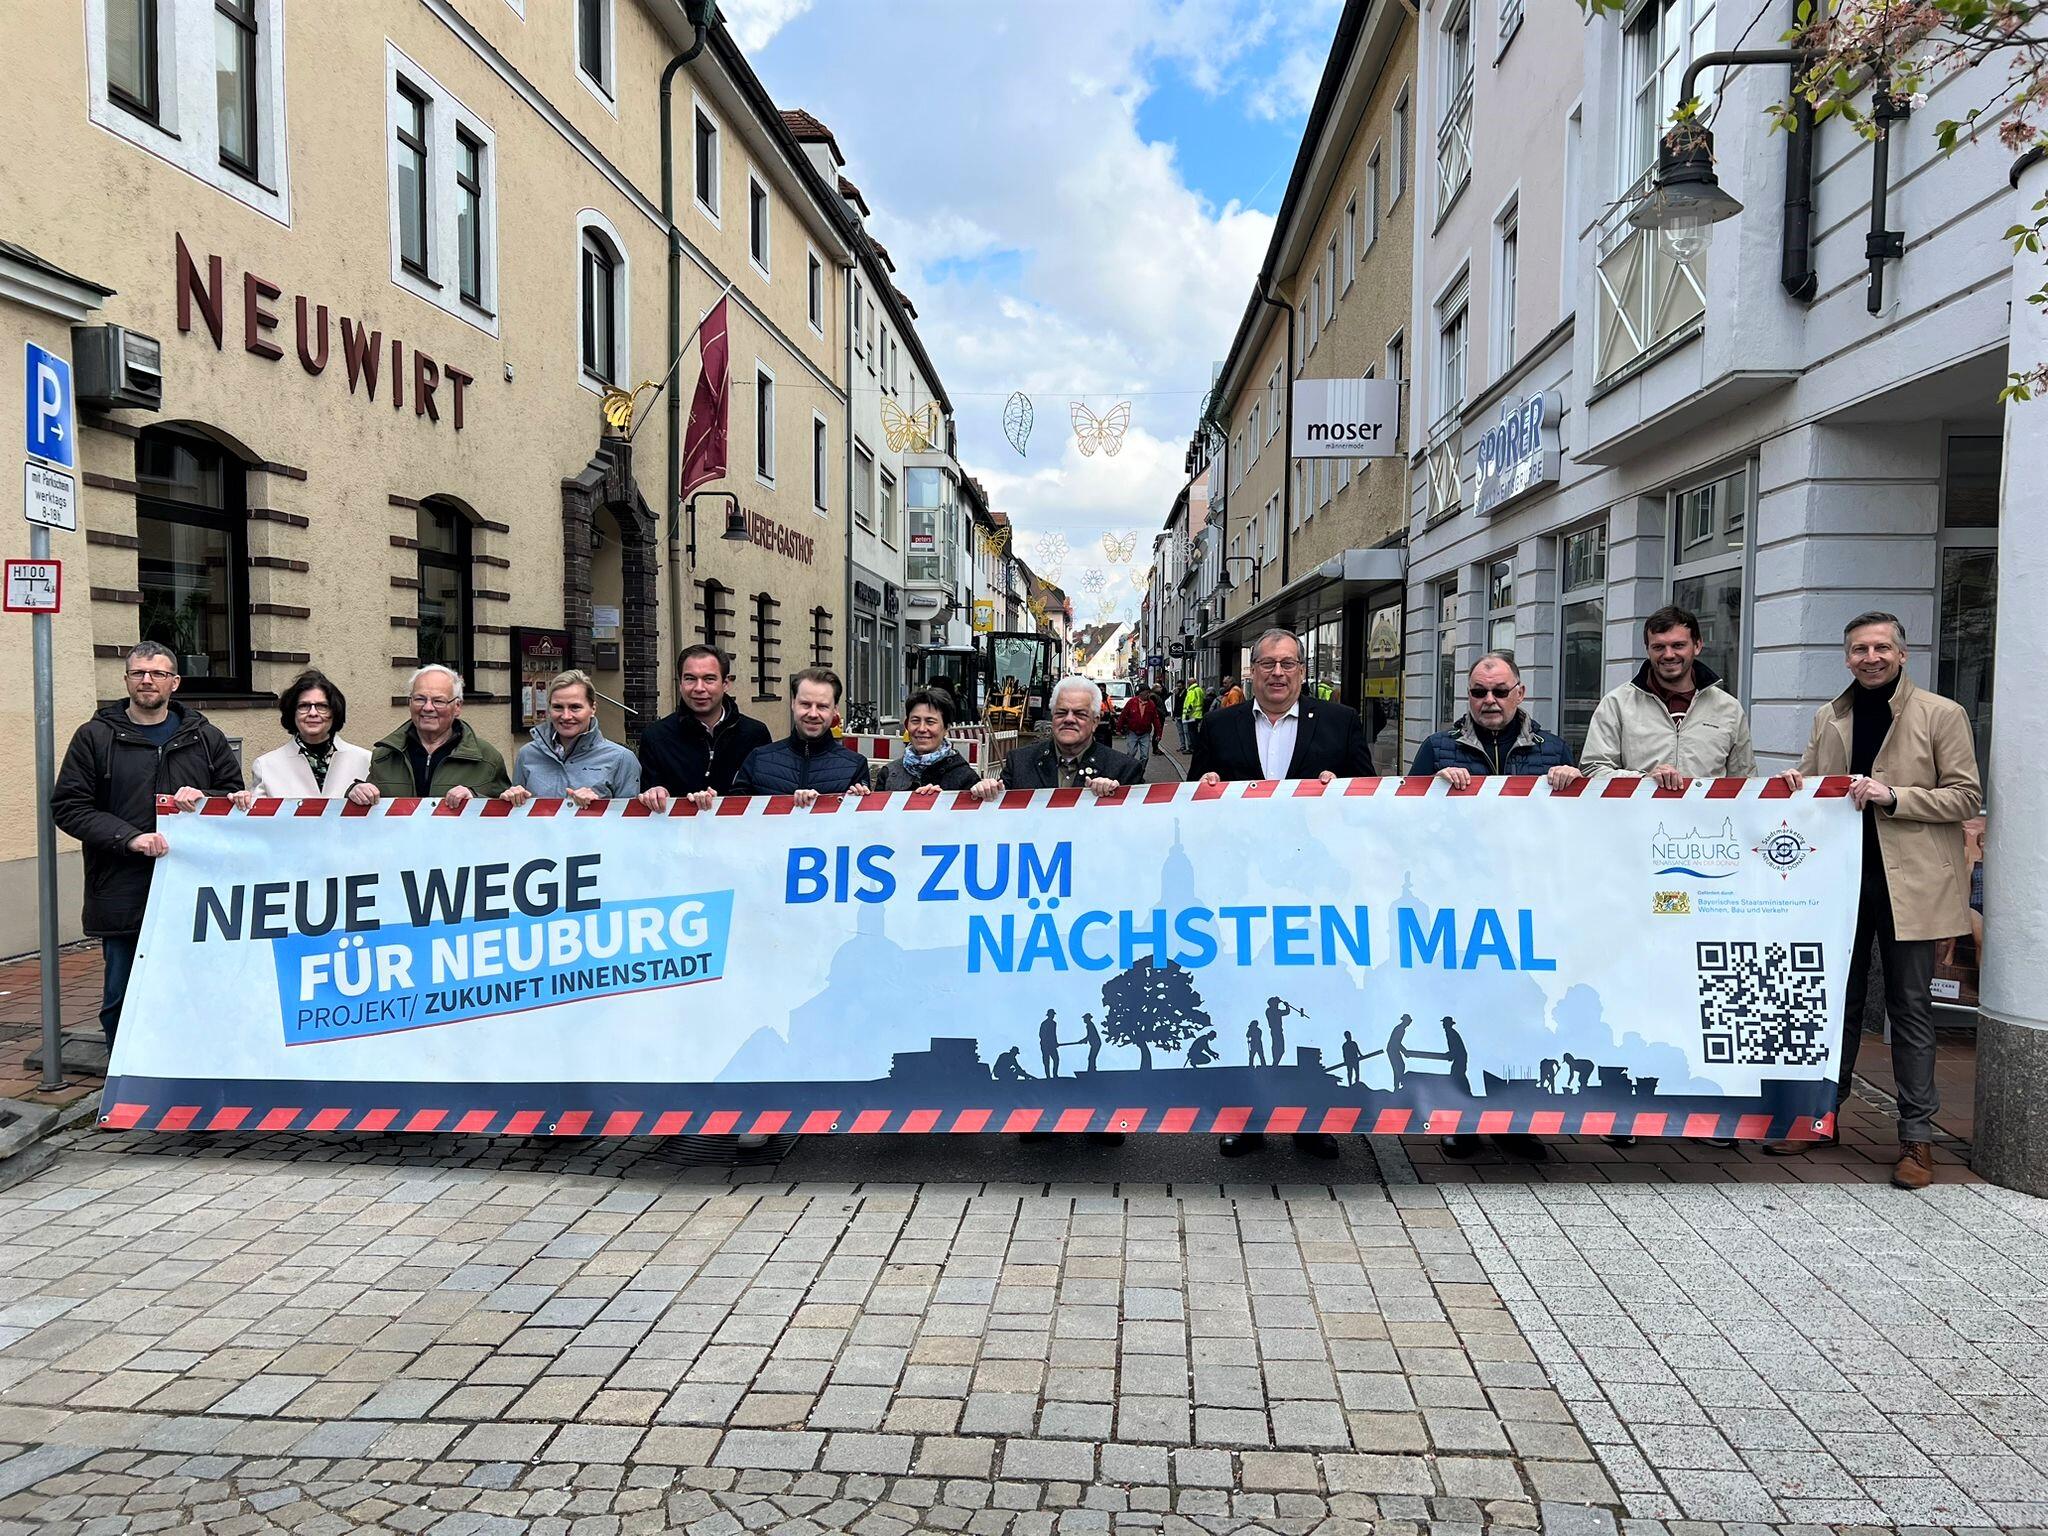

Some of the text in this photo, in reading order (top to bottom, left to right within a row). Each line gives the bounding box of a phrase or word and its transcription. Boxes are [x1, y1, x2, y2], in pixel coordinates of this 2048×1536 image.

[176, 231, 474, 429] NEUWIRT
[38, 362, 61, 444] P
[1308, 423, 1382, 440] moser
[32, 471, 69, 492] mit Parkschein
[35, 491, 67, 509] werktags
[42, 506, 61, 521] 8-18h
[726, 500, 814, 566] BAUEREI-GASTHOF
[1652, 843, 1740, 860] NEUBURG
[1762, 828, 1806, 845] Stadtmarketing
[785, 841, 1072, 904] BIS ZUM
[193, 853, 602, 942] NEUE WEGE
[1698, 898, 1739, 906] Bayerisches
[1740, 898, 1807, 906] Staatsministerium
[1761, 906, 1789, 914] Verkehr
[298, 901, 709, 1002] FÜR NEUBURG
[967, 896, 1557, 973] NÄCHSTEN MAL
[297, 953, 712, 1030] PROJEKT/ ZUKUNFT INNENSTADT
